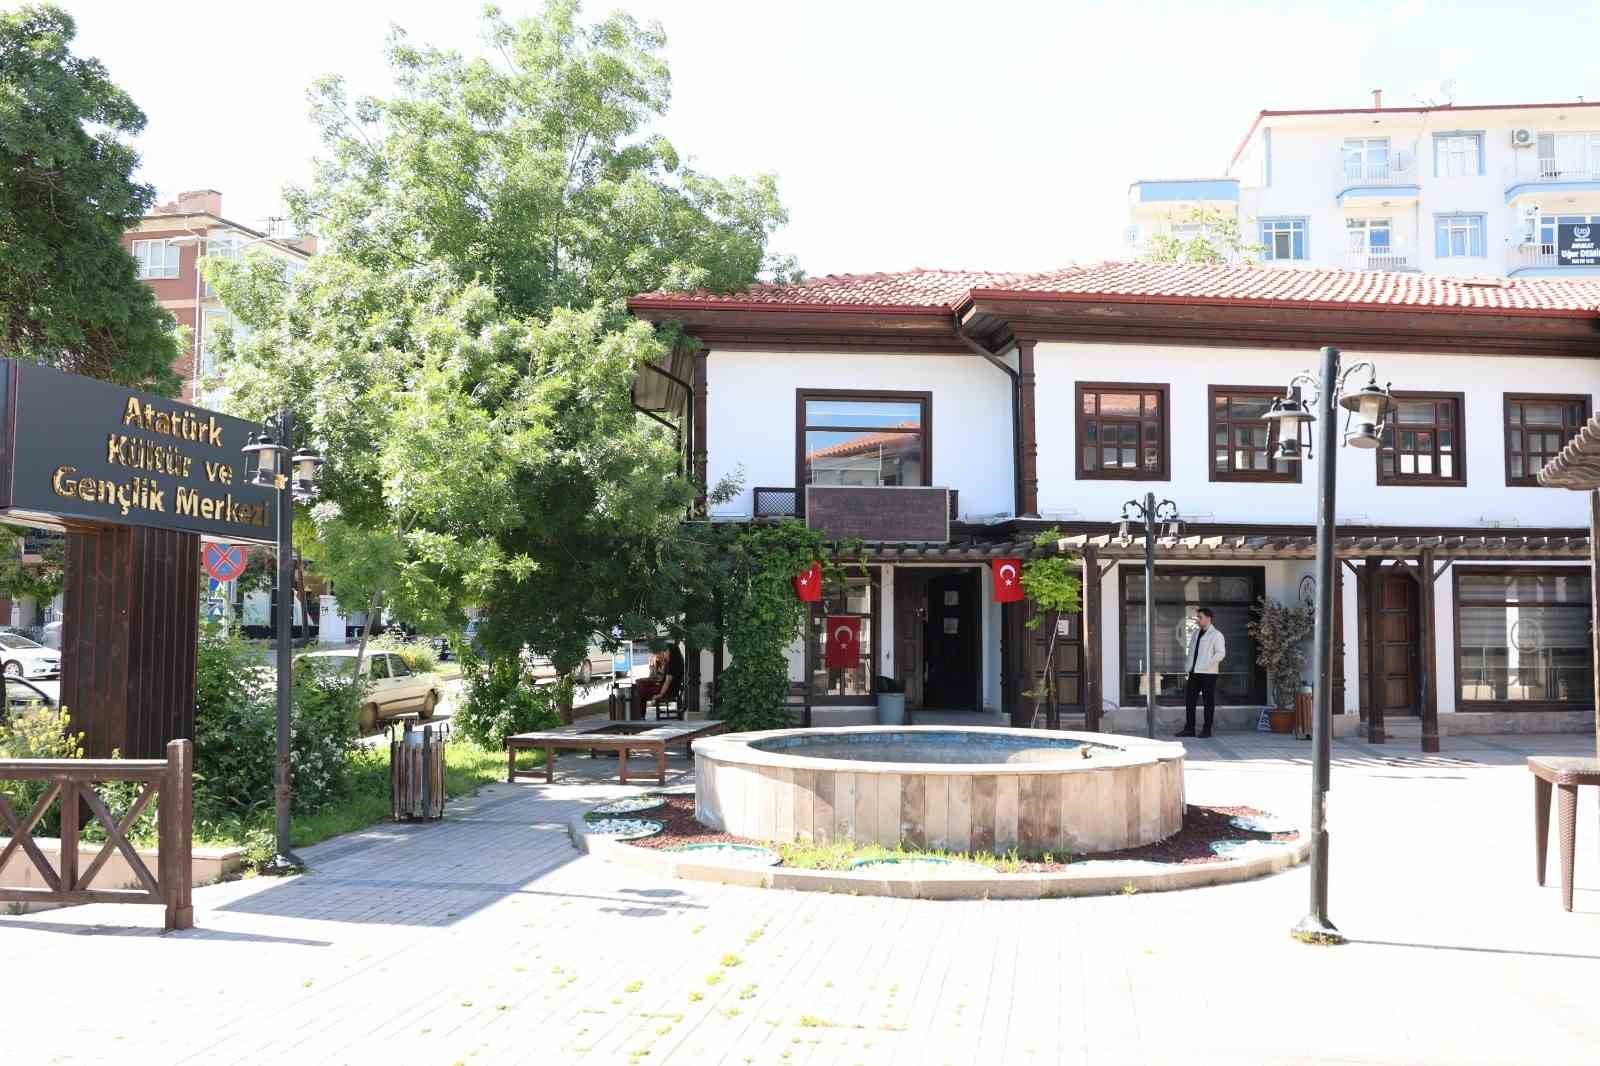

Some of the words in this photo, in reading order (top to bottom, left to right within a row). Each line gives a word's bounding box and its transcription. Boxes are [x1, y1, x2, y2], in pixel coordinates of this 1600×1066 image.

[123, 396, 223, 448] Atatürk
[52, 464, 165, 515] Gençlik
[175, 486, 269, 528] Merkezi
[205, 460, 233, 486] ve
